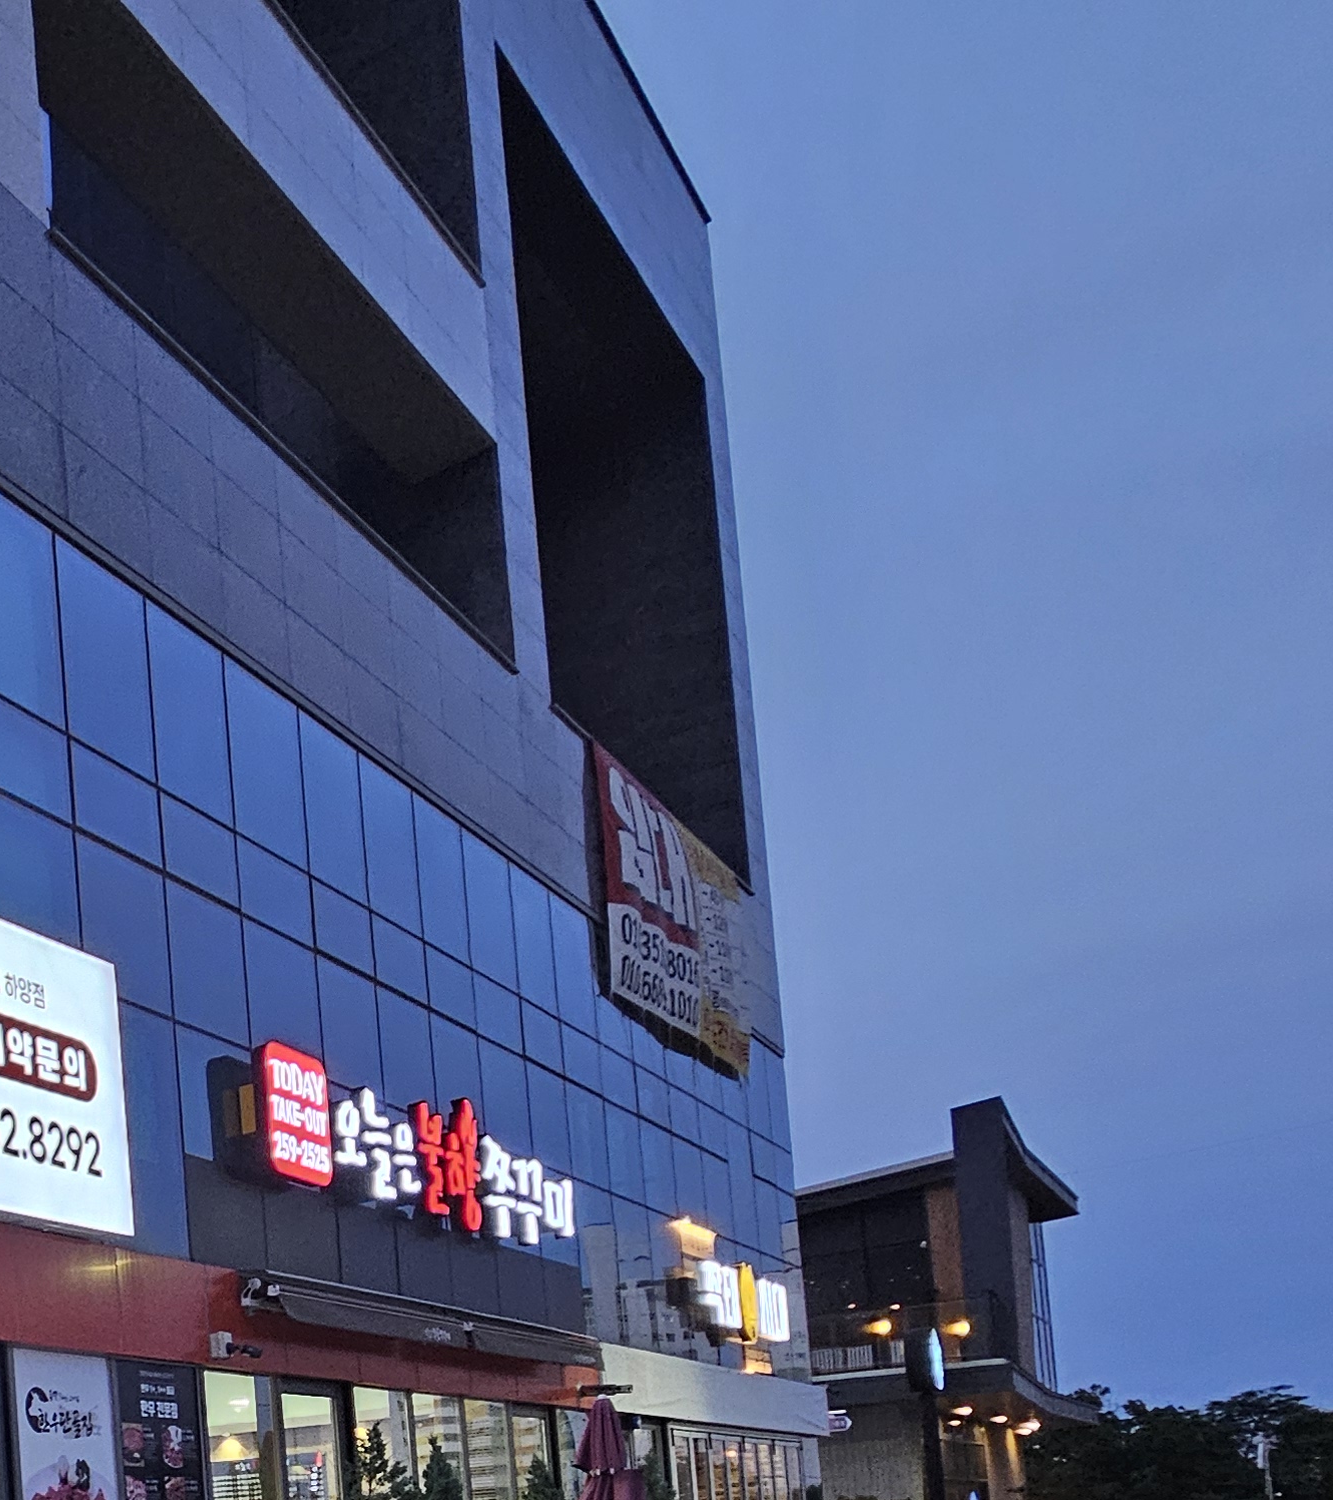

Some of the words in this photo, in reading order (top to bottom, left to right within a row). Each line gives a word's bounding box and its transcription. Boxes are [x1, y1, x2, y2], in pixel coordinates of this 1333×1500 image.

[4, 972, 46, 1009] 하양점
[269, 1059, 323, 1105] TODAY
[270, 1094, 327, 1137] TAKE-OUT
[273, 1131, 330, 1173] 259-2525
[334, 1086, 421, 1200] 오늘은
